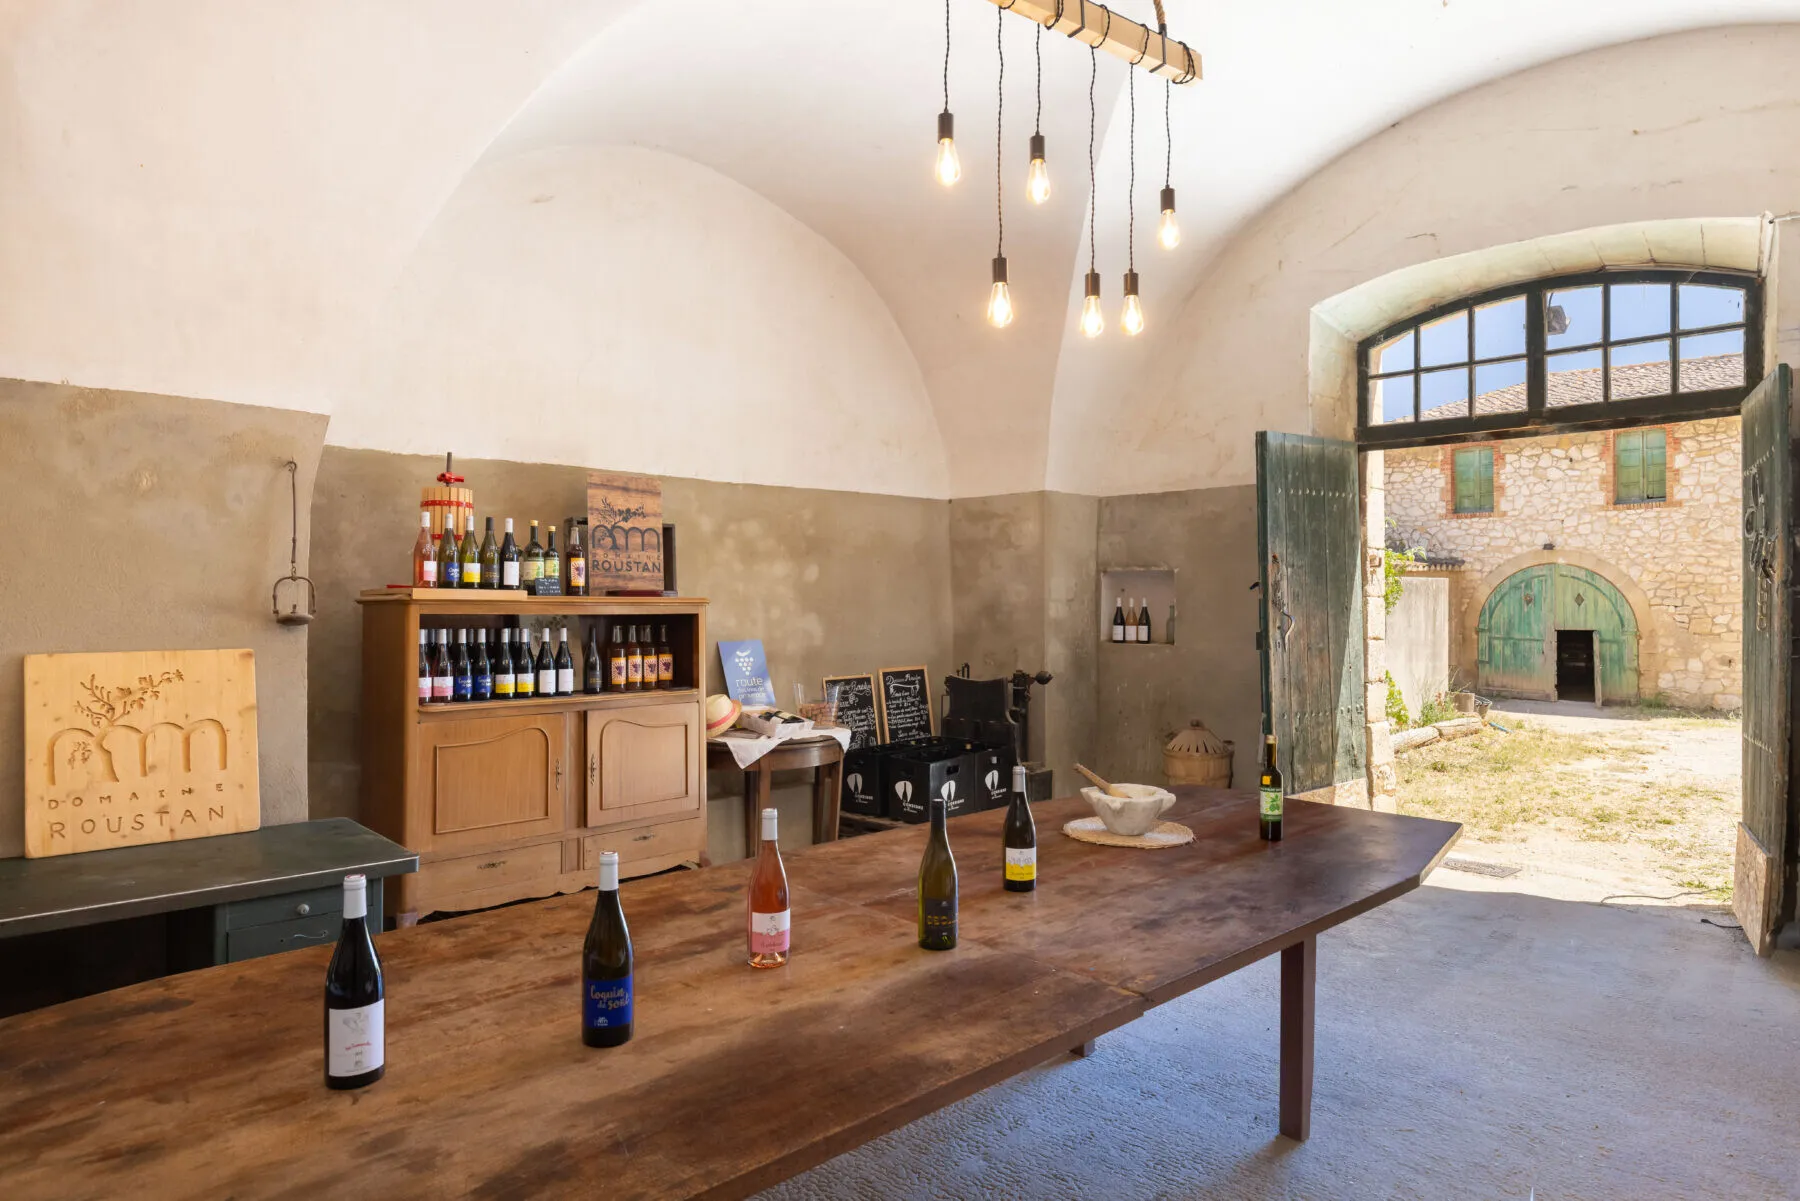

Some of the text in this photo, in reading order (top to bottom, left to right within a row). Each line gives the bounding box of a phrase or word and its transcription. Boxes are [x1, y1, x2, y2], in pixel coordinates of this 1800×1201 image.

[592, 560, 661, 572] ROUSTAN
[736, 677, 763, 687] route
[48, 783, 223, 809] DOMAINE
[50, 806, 224, 839] ROUSTAN
